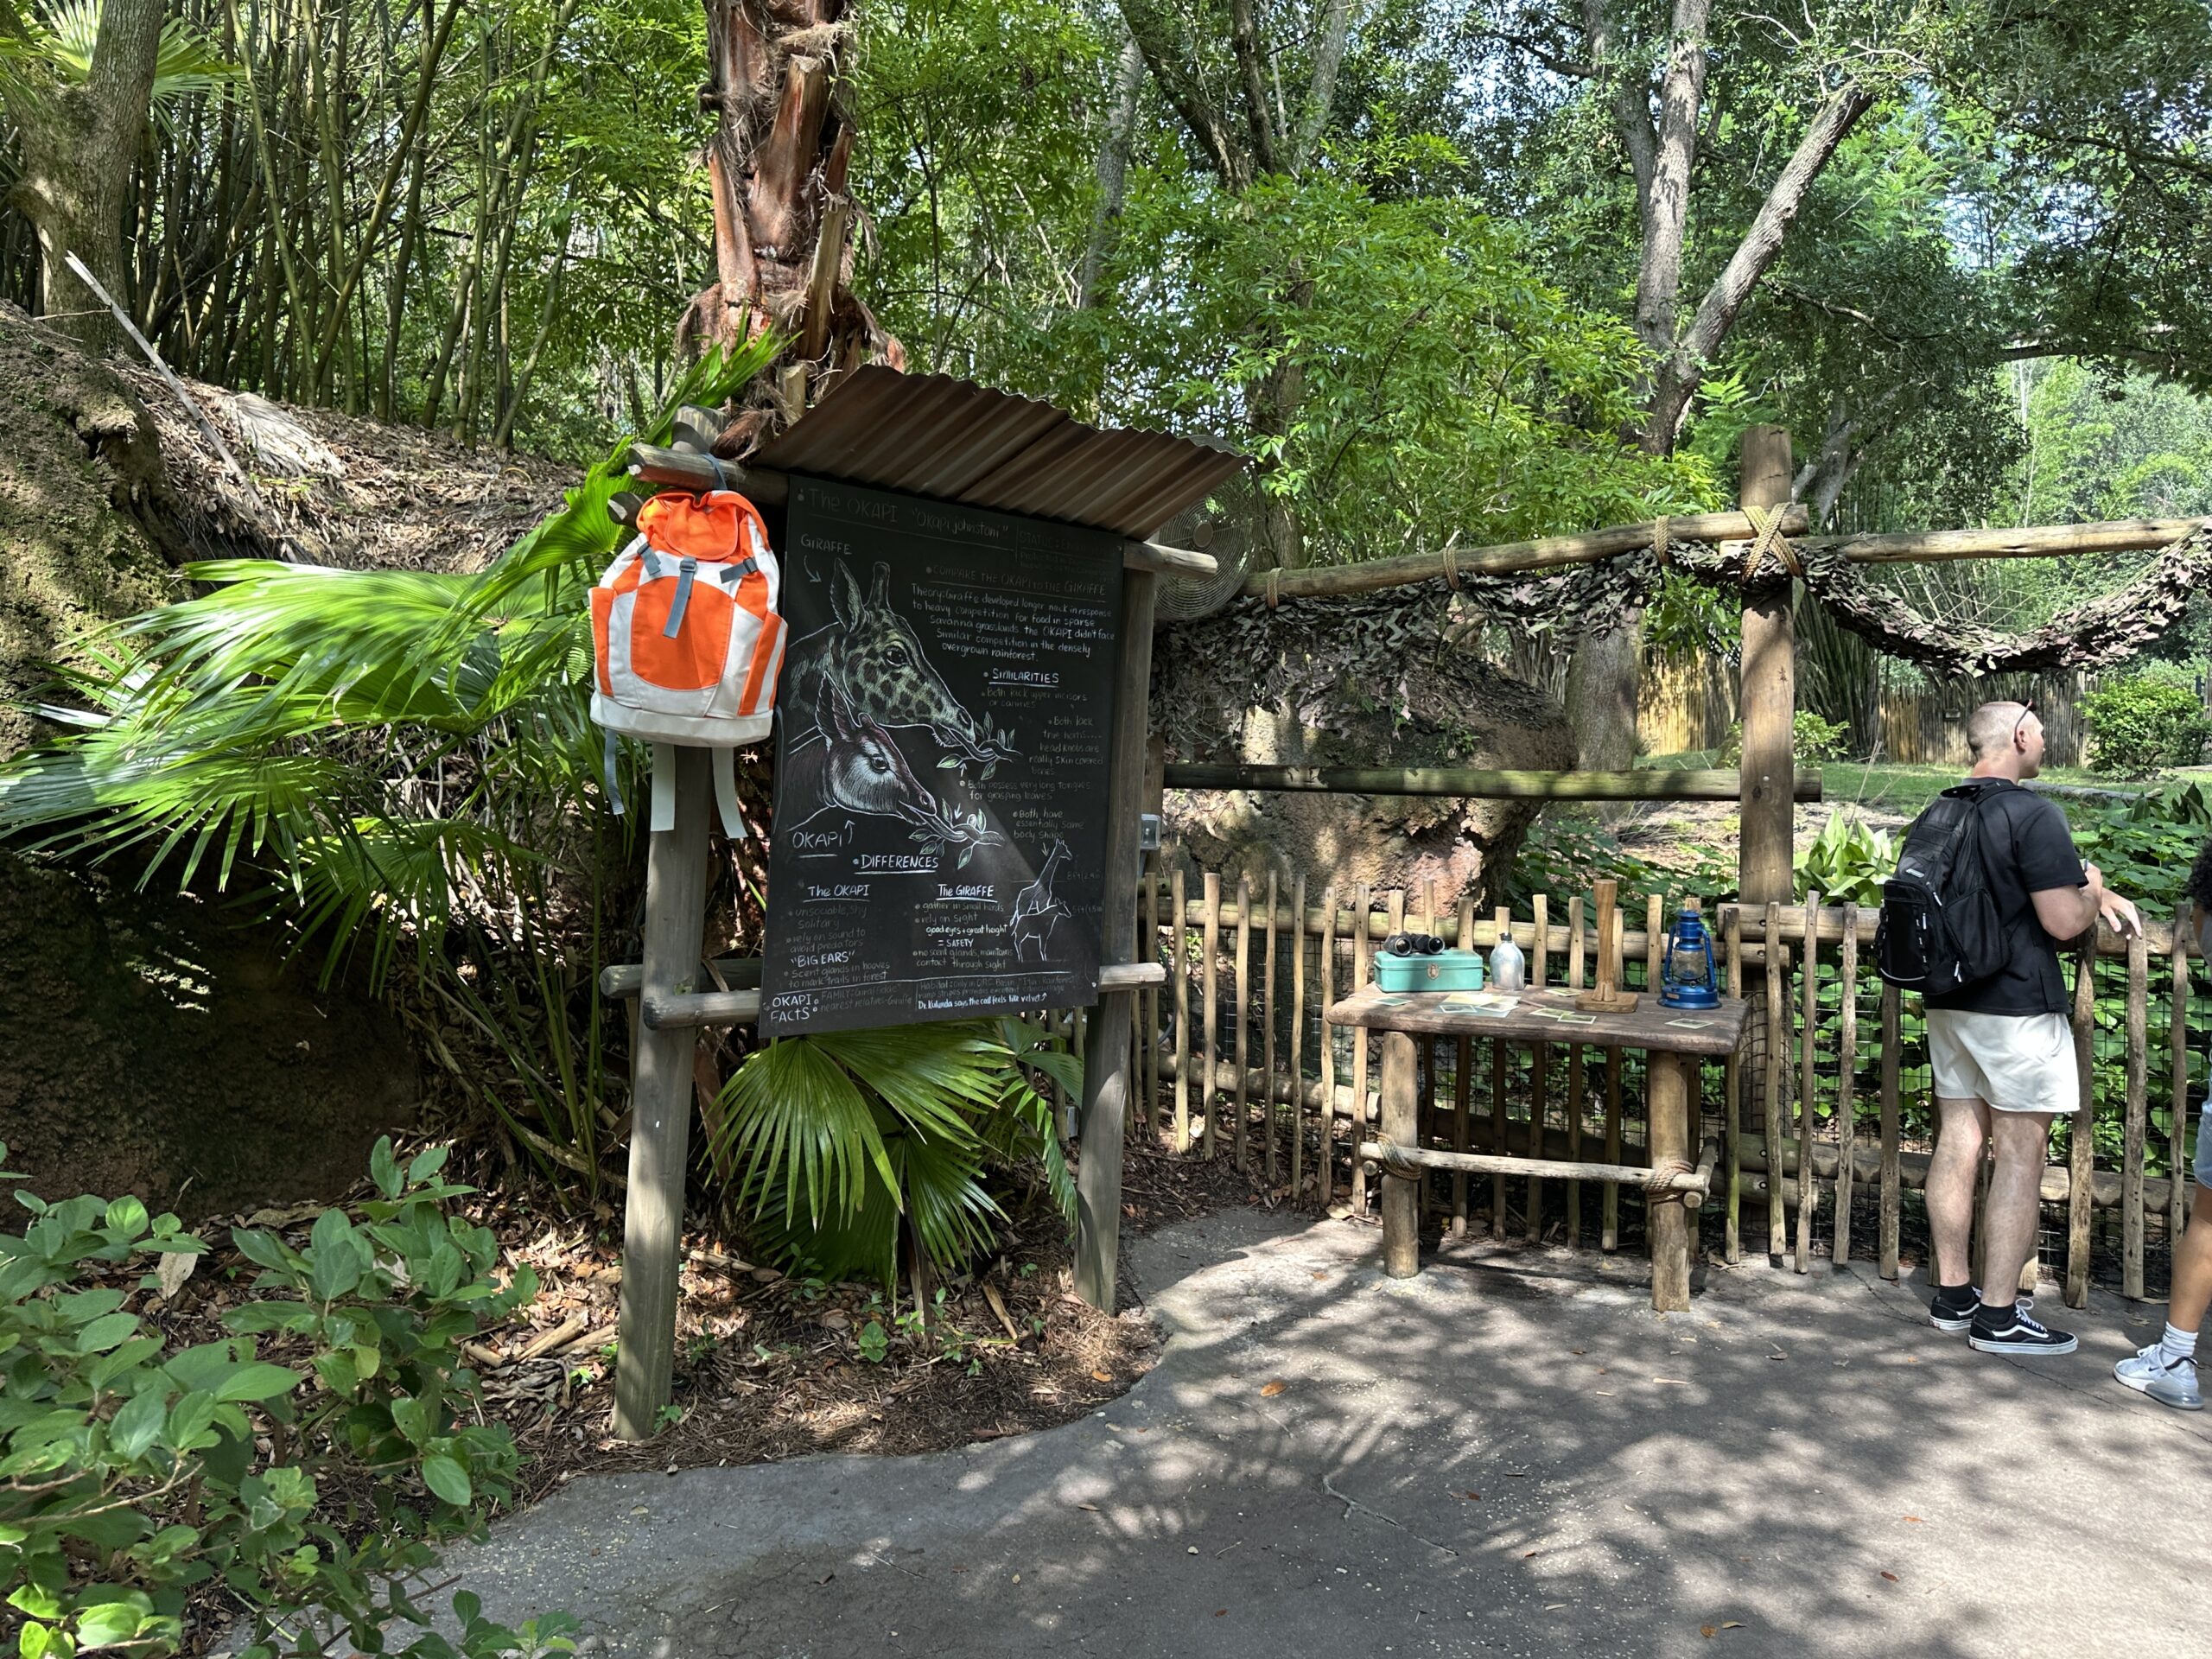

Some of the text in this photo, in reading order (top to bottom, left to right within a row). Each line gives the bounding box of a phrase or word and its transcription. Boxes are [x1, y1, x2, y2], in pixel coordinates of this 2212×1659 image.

[808, 488, 839, 512] The
[847, 499, 898, 523] OKAPI
[1001, 573, 1030, 588] OKAPI
[1065, 581, 1106, 595] GIRAFFE
[982, 593, 1019, 609] developed
[1021, 597, 1044, 612] longer
[1048, 604, 1067, 613] neck
[1078, 608, 1112, 618] response
[912, 600, 1096, 627] to heavy competition for food in sparse
[1024, 625, 1039, 636] the
[1043, 626, 1072, 639] OKAPI
[1098, 629, 1116, 640] face
[942, 642, 988, 658] overgrown
[976, 634, 1027, 648] competition
[1040, 639, 1055, 651] the
[1058, 642, 1091, 658] densely
[992, 667, 1059, 683] SIMILARITIES
[987, 687, 1006, 698] Both
[1054, 693, 1088, 702] incisors
[1053, 715, 1094, 727] Both lack
[1039, 741, 1061, 753] head
[1063, 742, 1084, 753] knobs
[1029, 753, 1052, 766] really
[1074, 756, 1103, 765] covered
[1031, 766, 1055, 775] bones
[988, 781, 1018, 790] possess
[1020, 781, 1038, 791] very
[1039, 780, 1056, 791] long
[969, 791, 983, 801] for
[1024, 791, 1052, 801] leaves
[1019, 807, 1064, 818] Both have
[1015, 817, 1058, 830] essentially
[792, 830, 842, 849] OKAPI
[1014, 830, 1035, 843] body
[860, 854, 938, 869] DIFFERENCES
[807, 884, 871, 897] The OKAPI
[938, 884, 995, 897] The GIRAFFE
[922, 901, 949, 912] gather
[983, 903, 1004, 912] herds
[921, 913, 937, 925] rely
[793, 931, 811, 944] rely
[829, 928, 855, 941] sound
[856, 927, 866, 937] to
[925, 925, 944, 937] good
[945, 927, 961, 937] eyes
[966, 925, 984, 936] great
[985, 924, 1007, 937] height
[790, 939, 863, 954] avoid predators
[946, 938, 974, 948] SAFETY
[980, 947, 1014, 956] maintains
[791, 950, 855, 968] "BIG EARS"
[916, 957, 946, 967] contact
[951, 957, 983, 970] through
[822, 964, 849, 978] glands
[852, 963, 861, 972] in
[862, 961, 891, 970] hooves
[789, 979, 799, 988] to
[802, 976, 823, 987] mark
[827, 975, 849, 985] trails
[862, 970, 887, 982] forest
[772, 994, 811, 1007] OKAPI
[969, 996, 979, 1006] the
[992, 995, 1007, 1005] feels
